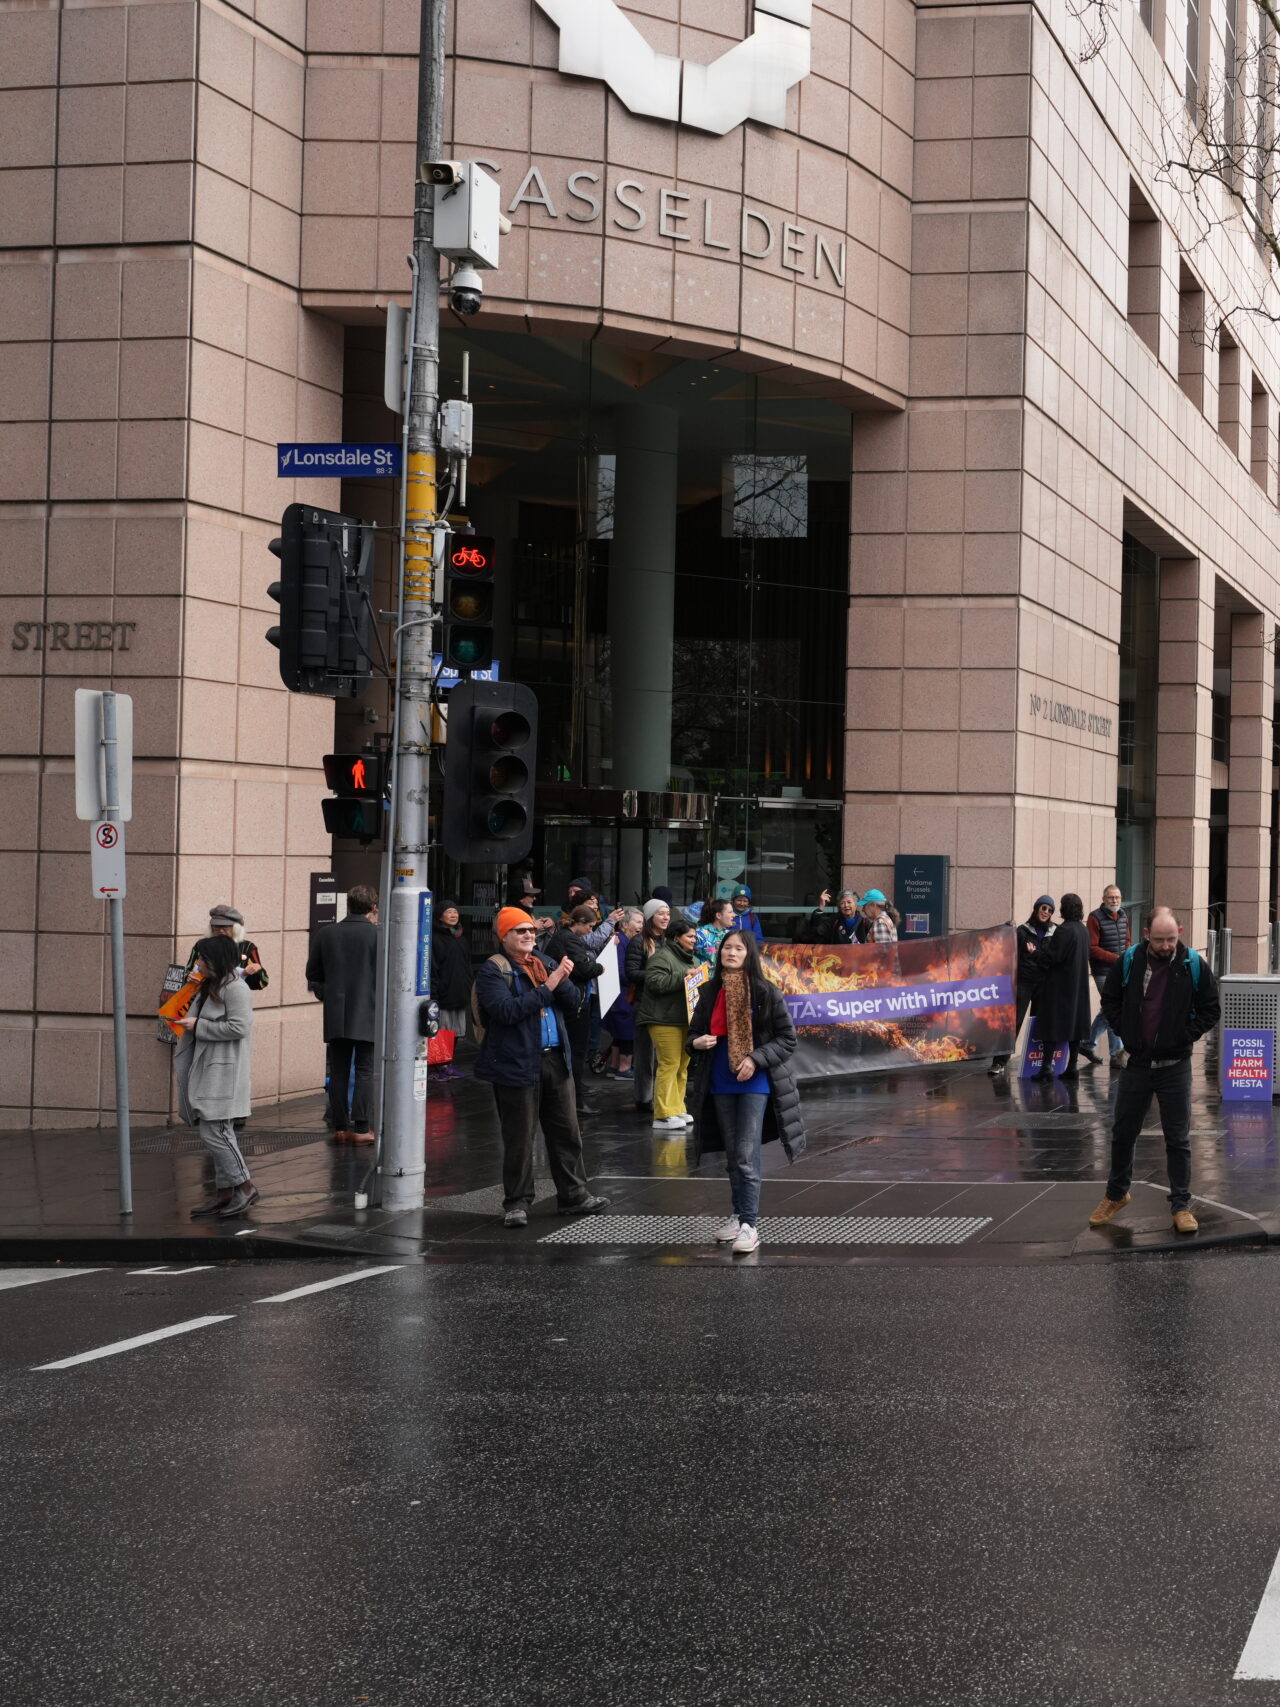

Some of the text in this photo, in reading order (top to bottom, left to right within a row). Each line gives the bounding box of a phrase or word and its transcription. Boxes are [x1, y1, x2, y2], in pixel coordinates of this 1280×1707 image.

[474, 158, 846, 288] ASSELDEN
[294, 449, 392, 465] Lonsdale St
[12, 621, 136, 651] STREET
[1043, 699, 1048, 720] 2
[1050, 701, 1086, 730] LONSDALE
[1088, 714, 1112, 738] STREET
[788, 983, 999, 1019] TA: Super with impact
[1232, 1039, 1265, 1047] FOSSIL
[1233, 1049, 1263, 1057] FUELS
[1233, 1059, 1263, 1067] HARM
[1228, 1069, 1267, 1077] HEALTH
[1232, 1080, 1263, 1088] HESTA
